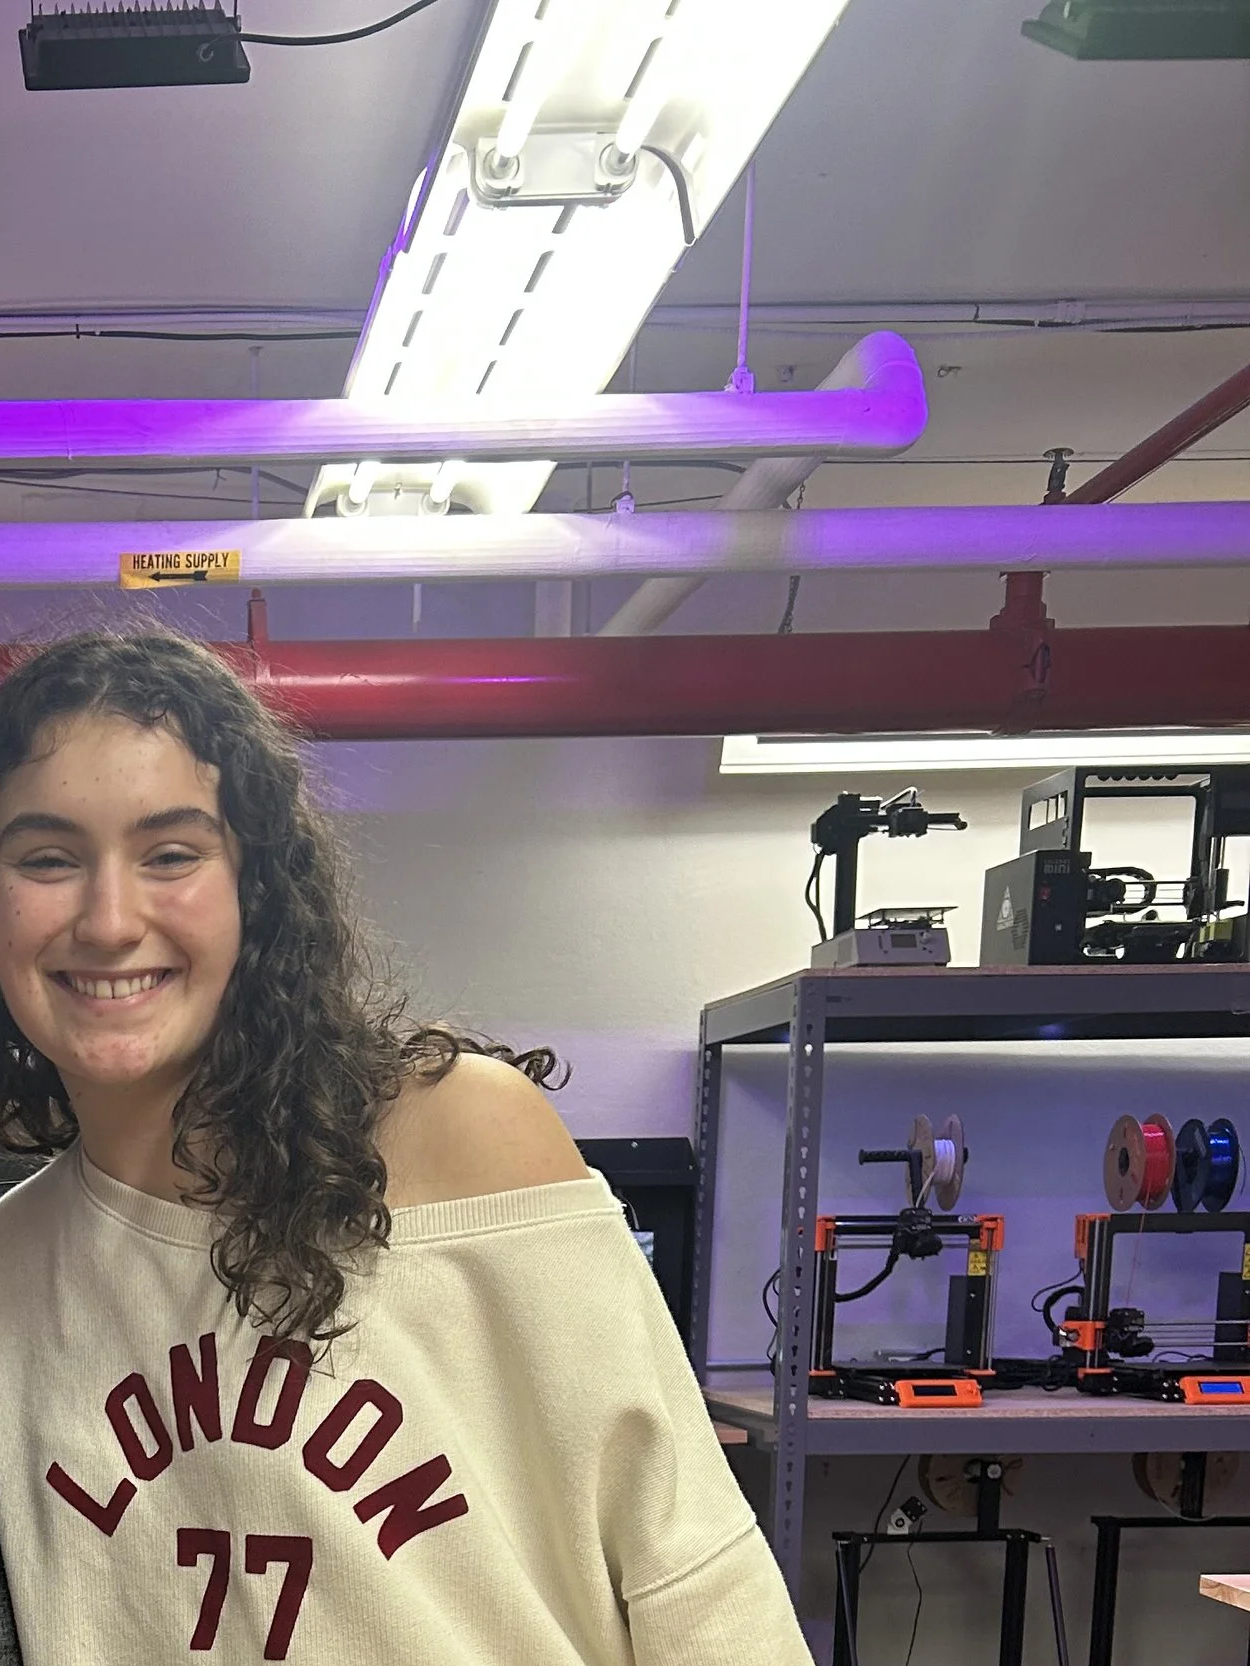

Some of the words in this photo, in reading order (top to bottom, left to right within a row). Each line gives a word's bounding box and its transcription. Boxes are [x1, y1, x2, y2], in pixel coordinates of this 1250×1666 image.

[133, 554, 181, 570] HEATING
[185, 552, 229, 568] SUPPLY
[45, 1333, 468, 1560] LONDON
[177, 1528, 313, 1660] 77
